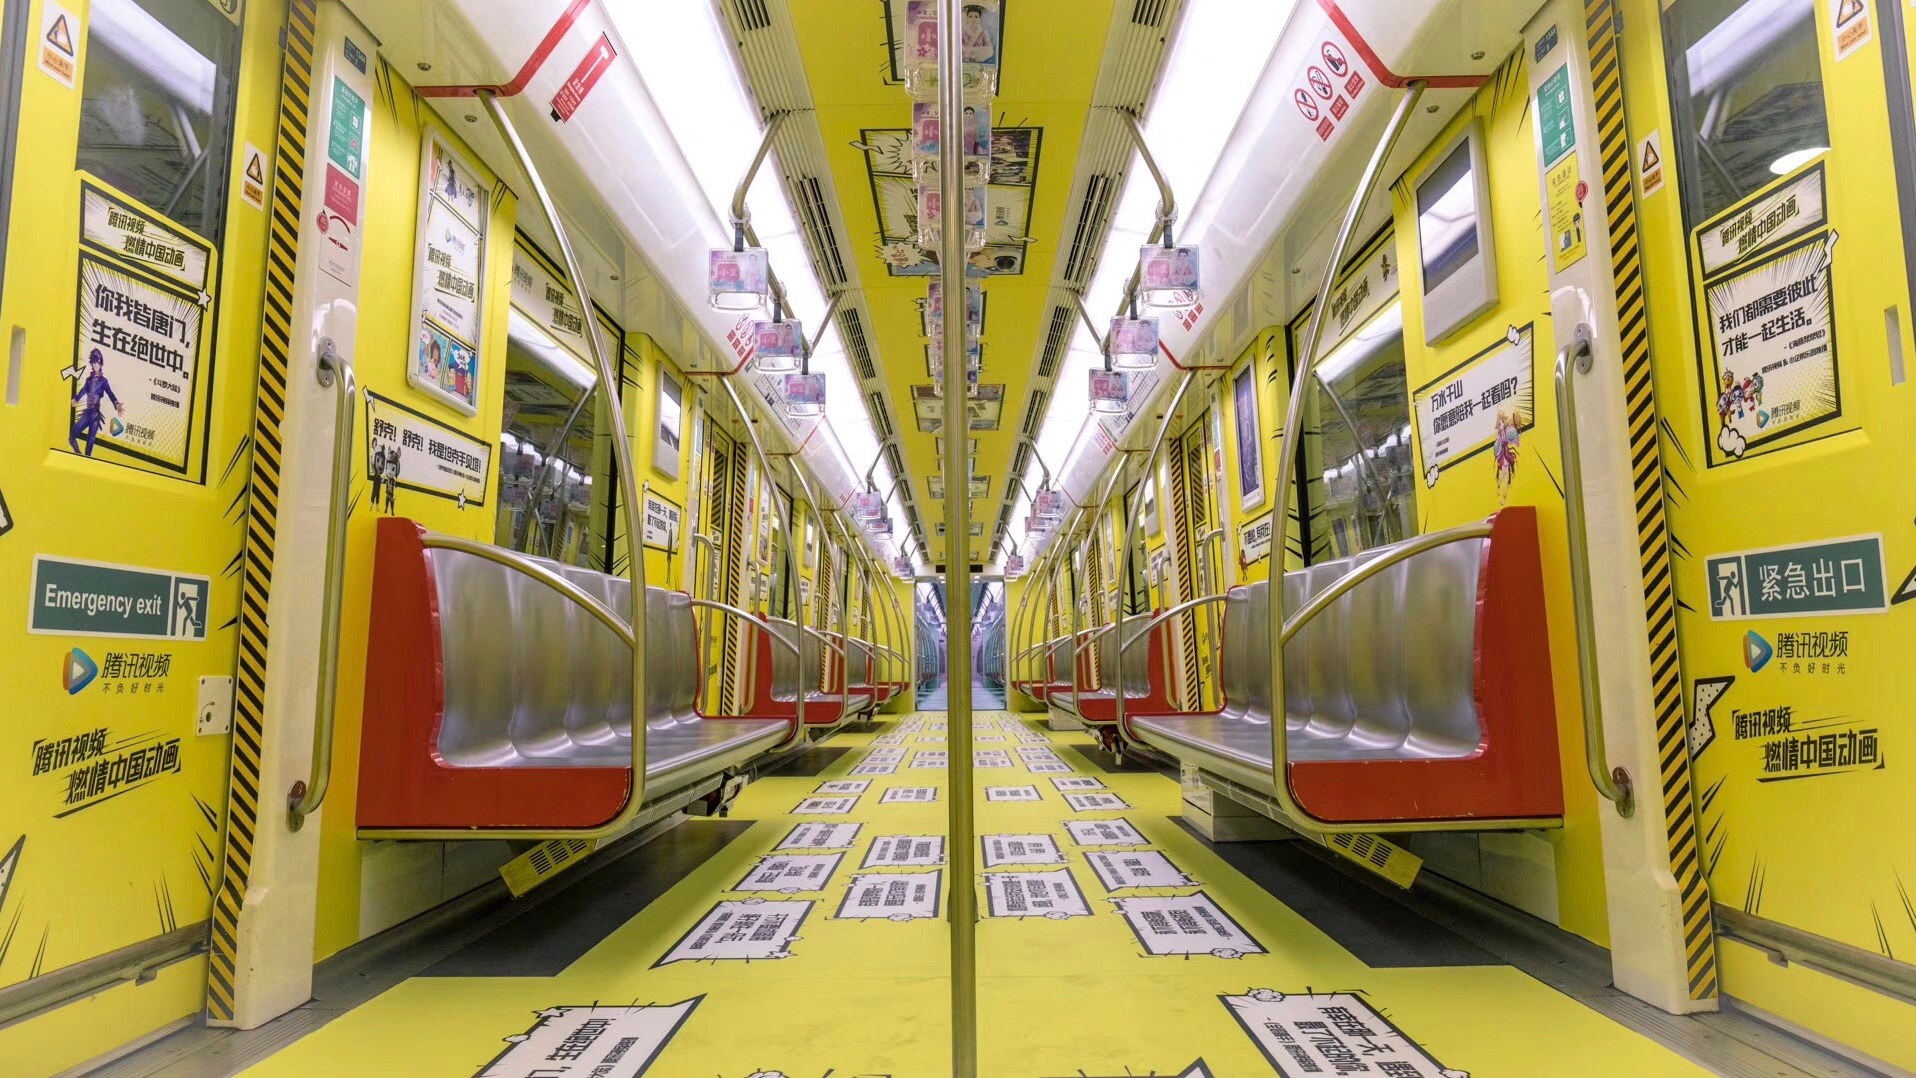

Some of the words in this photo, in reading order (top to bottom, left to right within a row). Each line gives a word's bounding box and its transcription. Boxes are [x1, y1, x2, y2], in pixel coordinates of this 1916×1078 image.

[95, 284, 191, 348] 你我皆唐门，
[1719, 273, 1819, 334] 我们都需要彼此
[91, 318, 189, 380] 生在绝世中。
[1721, 306, 1812, 357] 才能一起生活。
[1430, 380, 1464, 412] 万水千山
[1432, 376, 1518, 435] 你愿意陪我一起看吗？
[1758, 558, 1866, 602] 紧急出口
[44, 583, 132, 619] Emergency
[136, 594, 162, 616] exit
[1776, 631, 1849, 659] 腾讯视频
[101, 652, 173, 679] 腾讯视频
[1779, 662, 1846, 675] 不负好时光
[102, 682, 165, 695] 不负好时光
